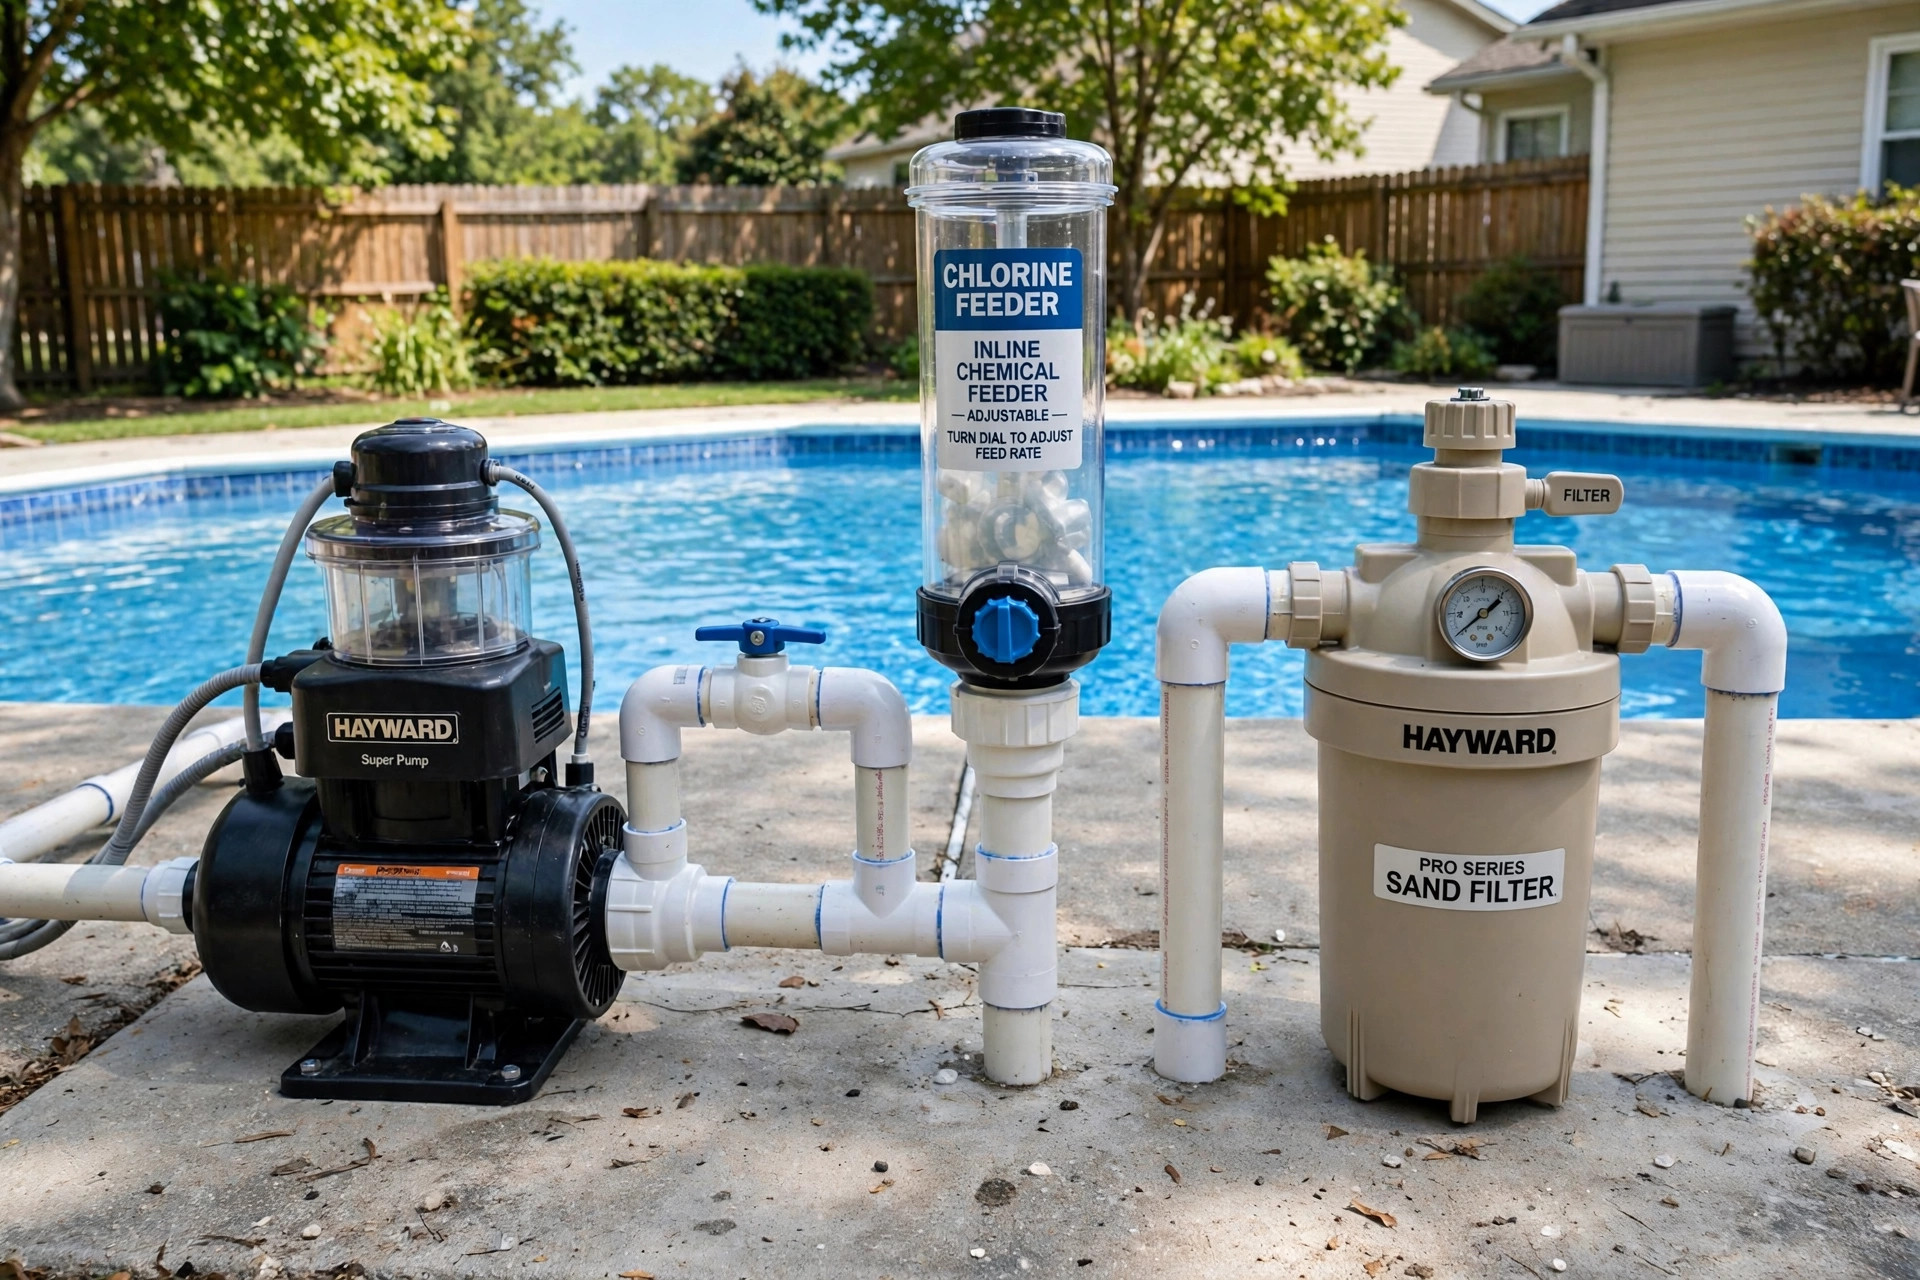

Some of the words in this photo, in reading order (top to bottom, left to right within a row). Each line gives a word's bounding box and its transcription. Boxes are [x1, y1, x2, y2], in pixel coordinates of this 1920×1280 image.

[943, 261, 1073, 289] CHLORINE
[956, 291, 1059, 317] FEEDER
[974, 340, 1040, 359] INLINE
[956, 362, 1060, 381] CHEMICAL
[968, 384, 1048, 403] FEEDER
[967, 408, 1049, 422] ADJUSTABLE
[947, 430, 977, 444] TURN
[979, 431, 1007, 445] DIAL
[1010, 431, 1027, 444] TO
[1030, 429, 1074, 444] ADJUST
[975, 447, 1007, 460] FEED
[1010, 446, 1042, 460] RATE
[1563, 488, 1611, 503] FILTER
[334, 717, 453, 740] HAYWARD
[361, 753, 394, 768] Super
[396, 754, 429, 769] Pump
[1419, 857, 1457, 875] PRO
[1463, 860, 1525, 876] SERIES
[1386, 870, 1461, 902] SAND
